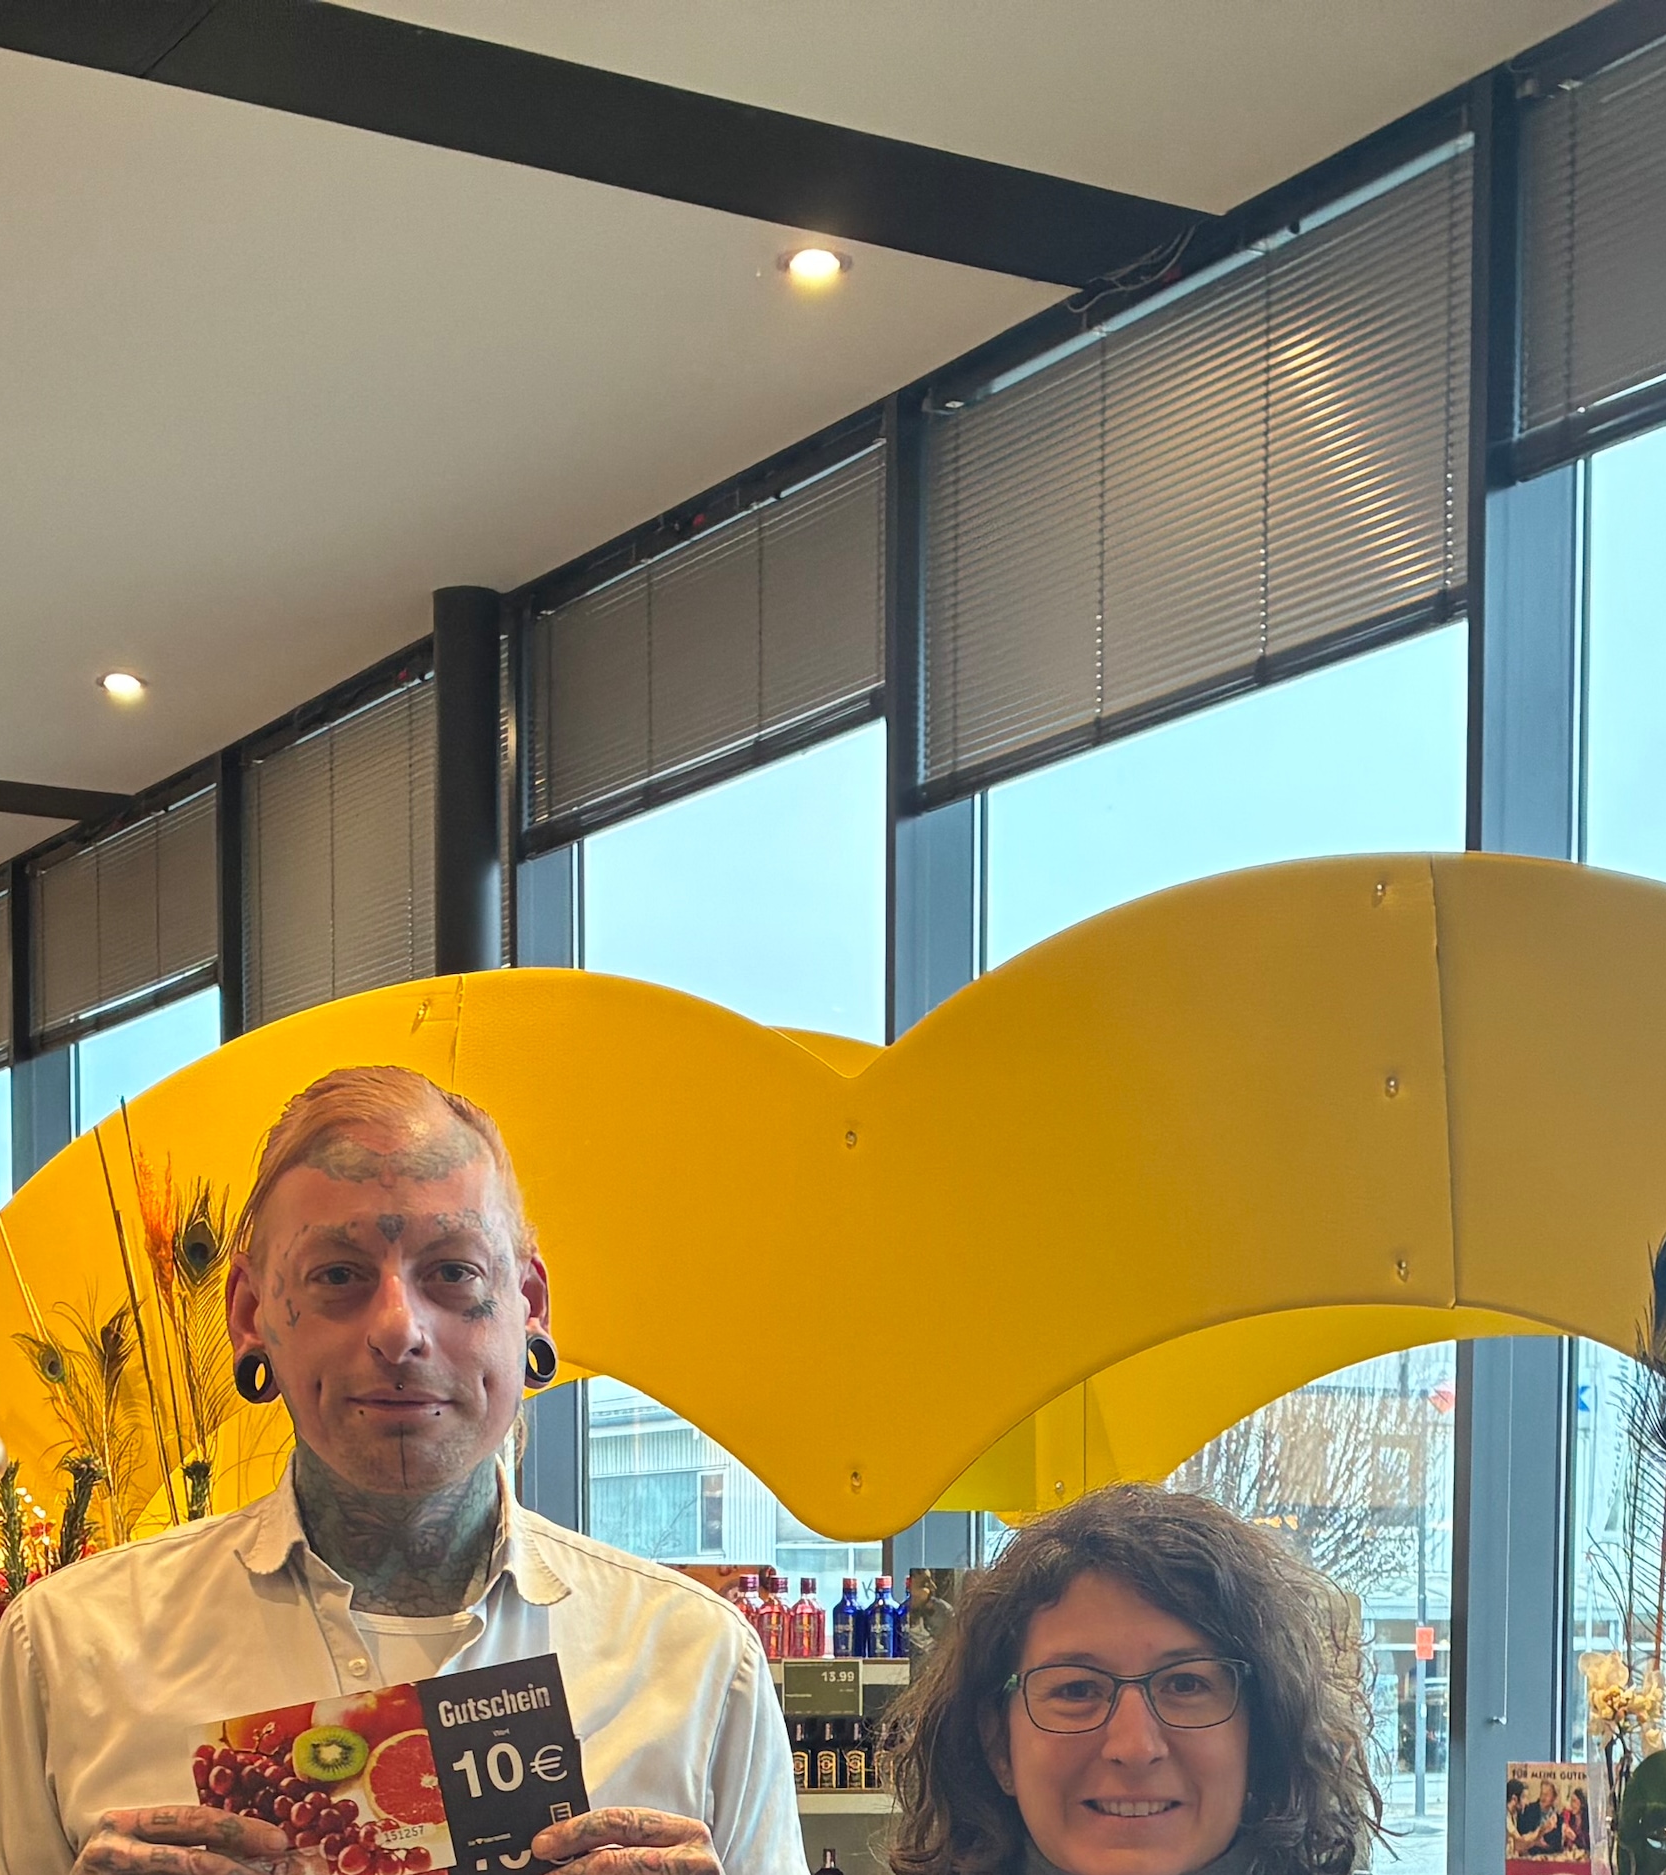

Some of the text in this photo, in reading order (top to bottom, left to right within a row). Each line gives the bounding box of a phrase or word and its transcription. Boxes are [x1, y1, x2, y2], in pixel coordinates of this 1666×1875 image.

[438, 1683, 552, 1728] Gutschein
[452, 1742, 568, 1798] 10€
[384, 1826, 425, 1843] 151257
